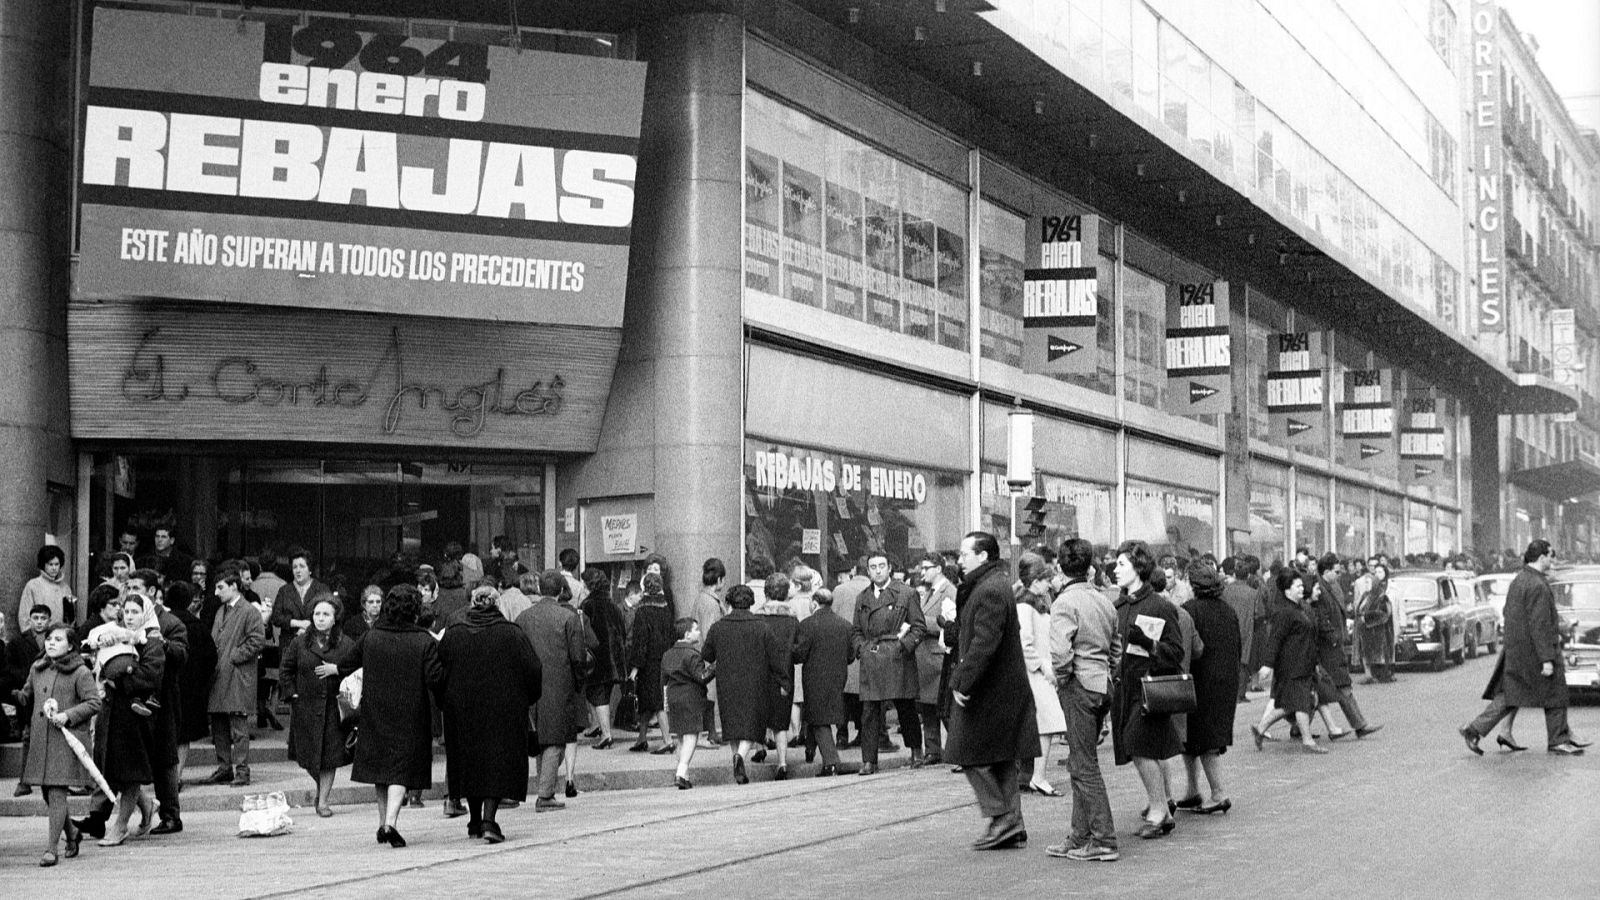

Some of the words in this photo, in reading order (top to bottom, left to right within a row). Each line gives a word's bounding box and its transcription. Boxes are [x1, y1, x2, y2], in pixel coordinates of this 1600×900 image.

[263, 20, 491, 84] 1964
[1473, 0, 1495, 127] ORTE
[259, 62, 486, 122] enero
[83, 105, 638, 228] REBAJAS
[1042, 215, 1081, 242] 1964
[1479, 145, 1500, 326] INGLES
[121, 227, 169, 263] ESTE
[174, 228, 217, 266] AÑO
[221, 239, 316, 272] SUPERAN
[319, 242, 334, 273] A
[339, 243, 404, 280] TODOS
[409, 249, 446, 283] LOS
[450, 252, 585, 293] PRECEDENTES
[1042, 241, 1081, 269] enero
[1024, 279, 1097, 317] REBAJAS
[1180, 283, 1214, 306] 1964
[1180, 304, 1215, 328] enero
[1165, 335, 1230, 369] REBAJAS
[1280, 333, 1308, 352] 1964
[210, 355, 367, 404] Corte
[1267, 377, 1322, 405] REBAJAS
[755, 450, 836, 493] REBAJAS
[842, 463, 861, 491] DE
[870, 466, 926, 503] ENERO
